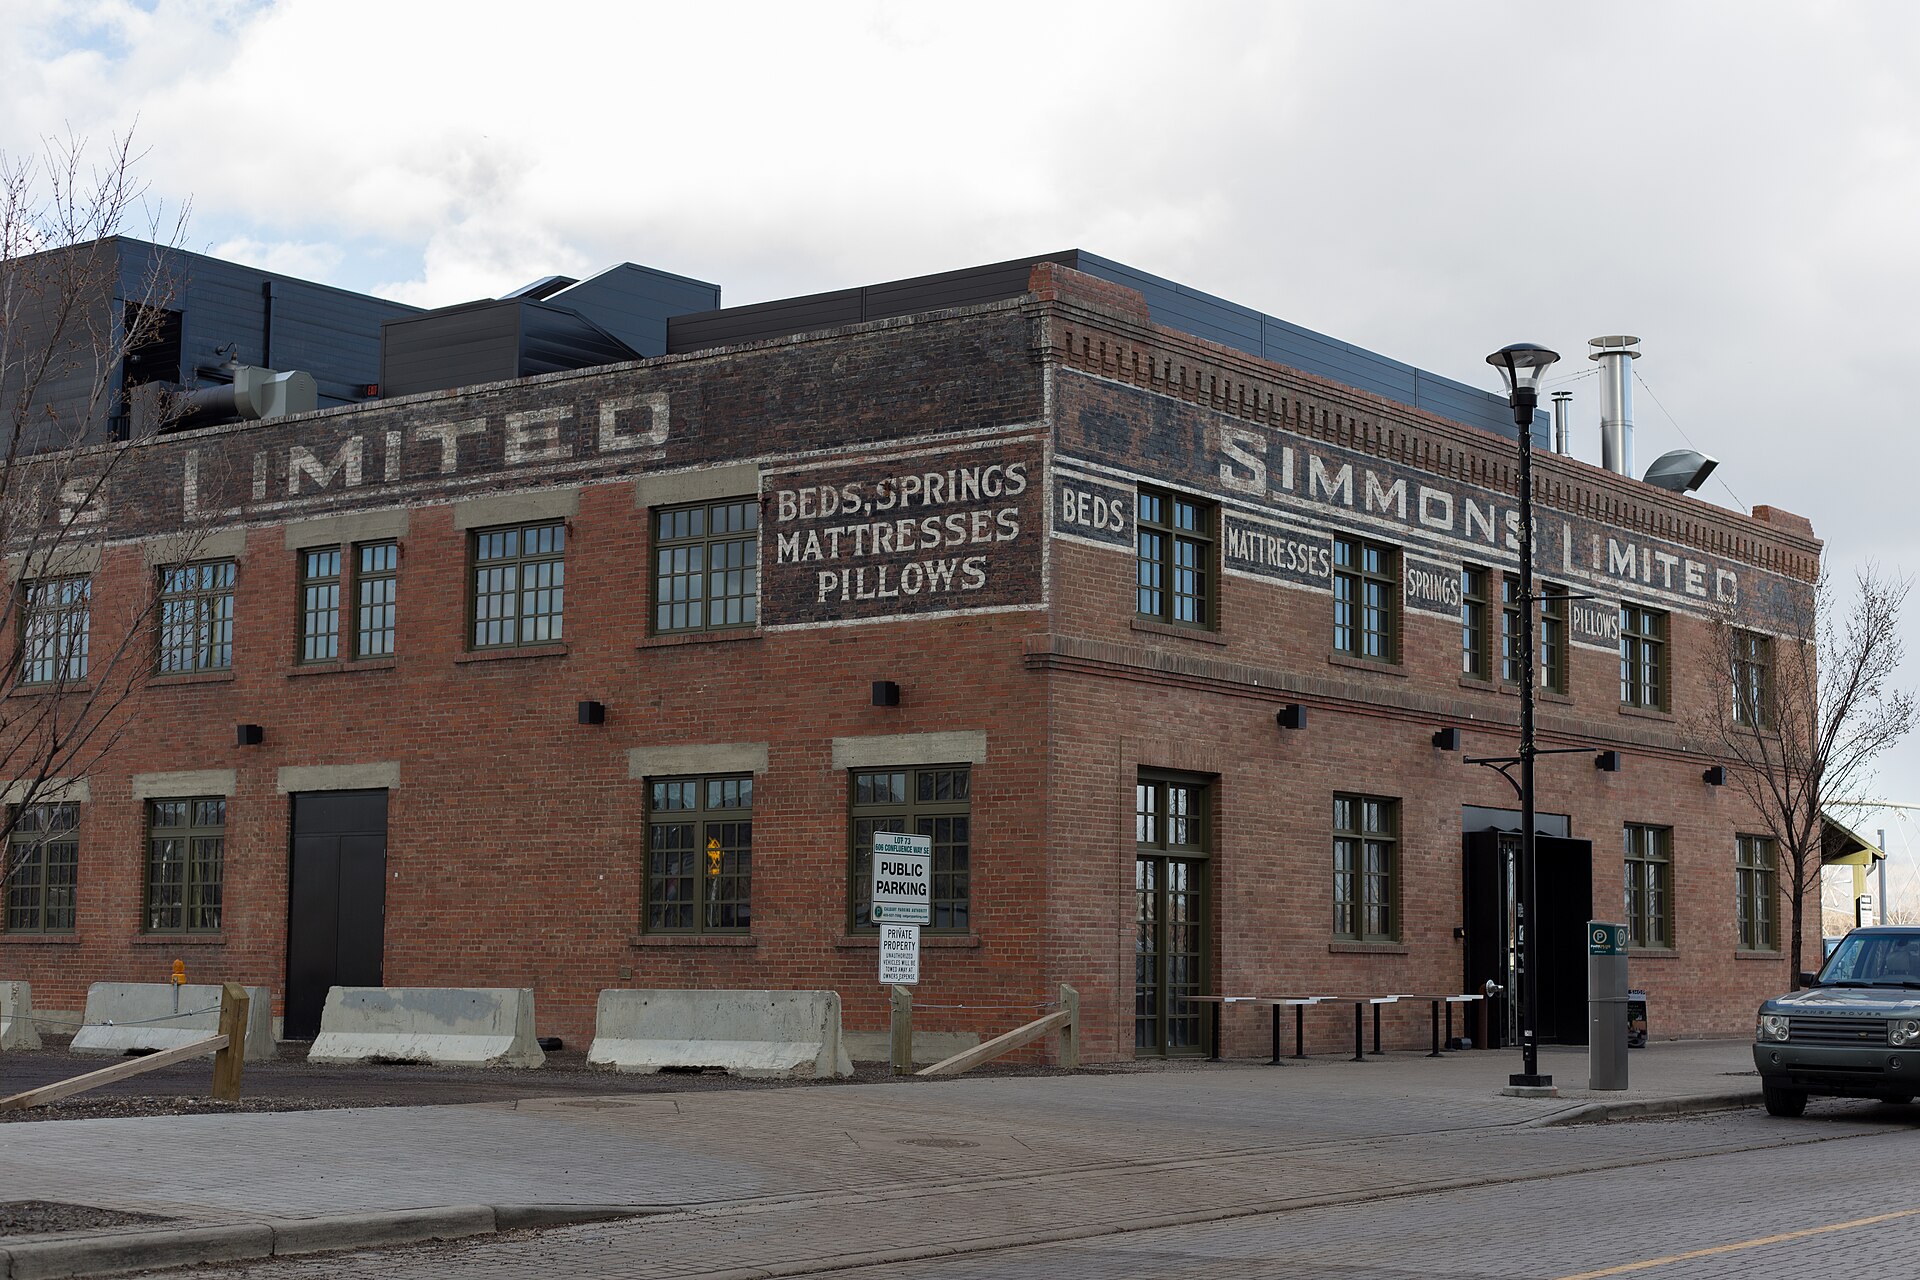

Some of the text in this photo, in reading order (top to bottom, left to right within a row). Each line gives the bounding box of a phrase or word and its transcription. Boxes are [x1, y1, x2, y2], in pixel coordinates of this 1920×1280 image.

[182, 393, 670, 522] LIMITED
[777, 462, 1027, 522] BEDS, SPRINGS
[1062, 487, 1125, 533] BEDS
[776, 507, 1020, 564] MATTRESSES
[1219, 424, 1740, 607] SIMMONS LIMITED
[1228, 526, 1330, 579] MATTRESSES
[816, 555, 987, 603] PILLOWS
[1407, 567, 1459, 607] SPRINGS
[1573, 606, 1619, 641] PILLOWS
[884, 844, 913, 853] CONFLUENCE
[913, 846, 923, 854] WAY
[894, 836, 904, 844] LOT
[876, 880, 927, 896] PARKING
[881, 861, 923, 877] PUBLIC
[884, 941, 915, 950] PROPERTY
[887, 929, 912, 939] PRIVATE
